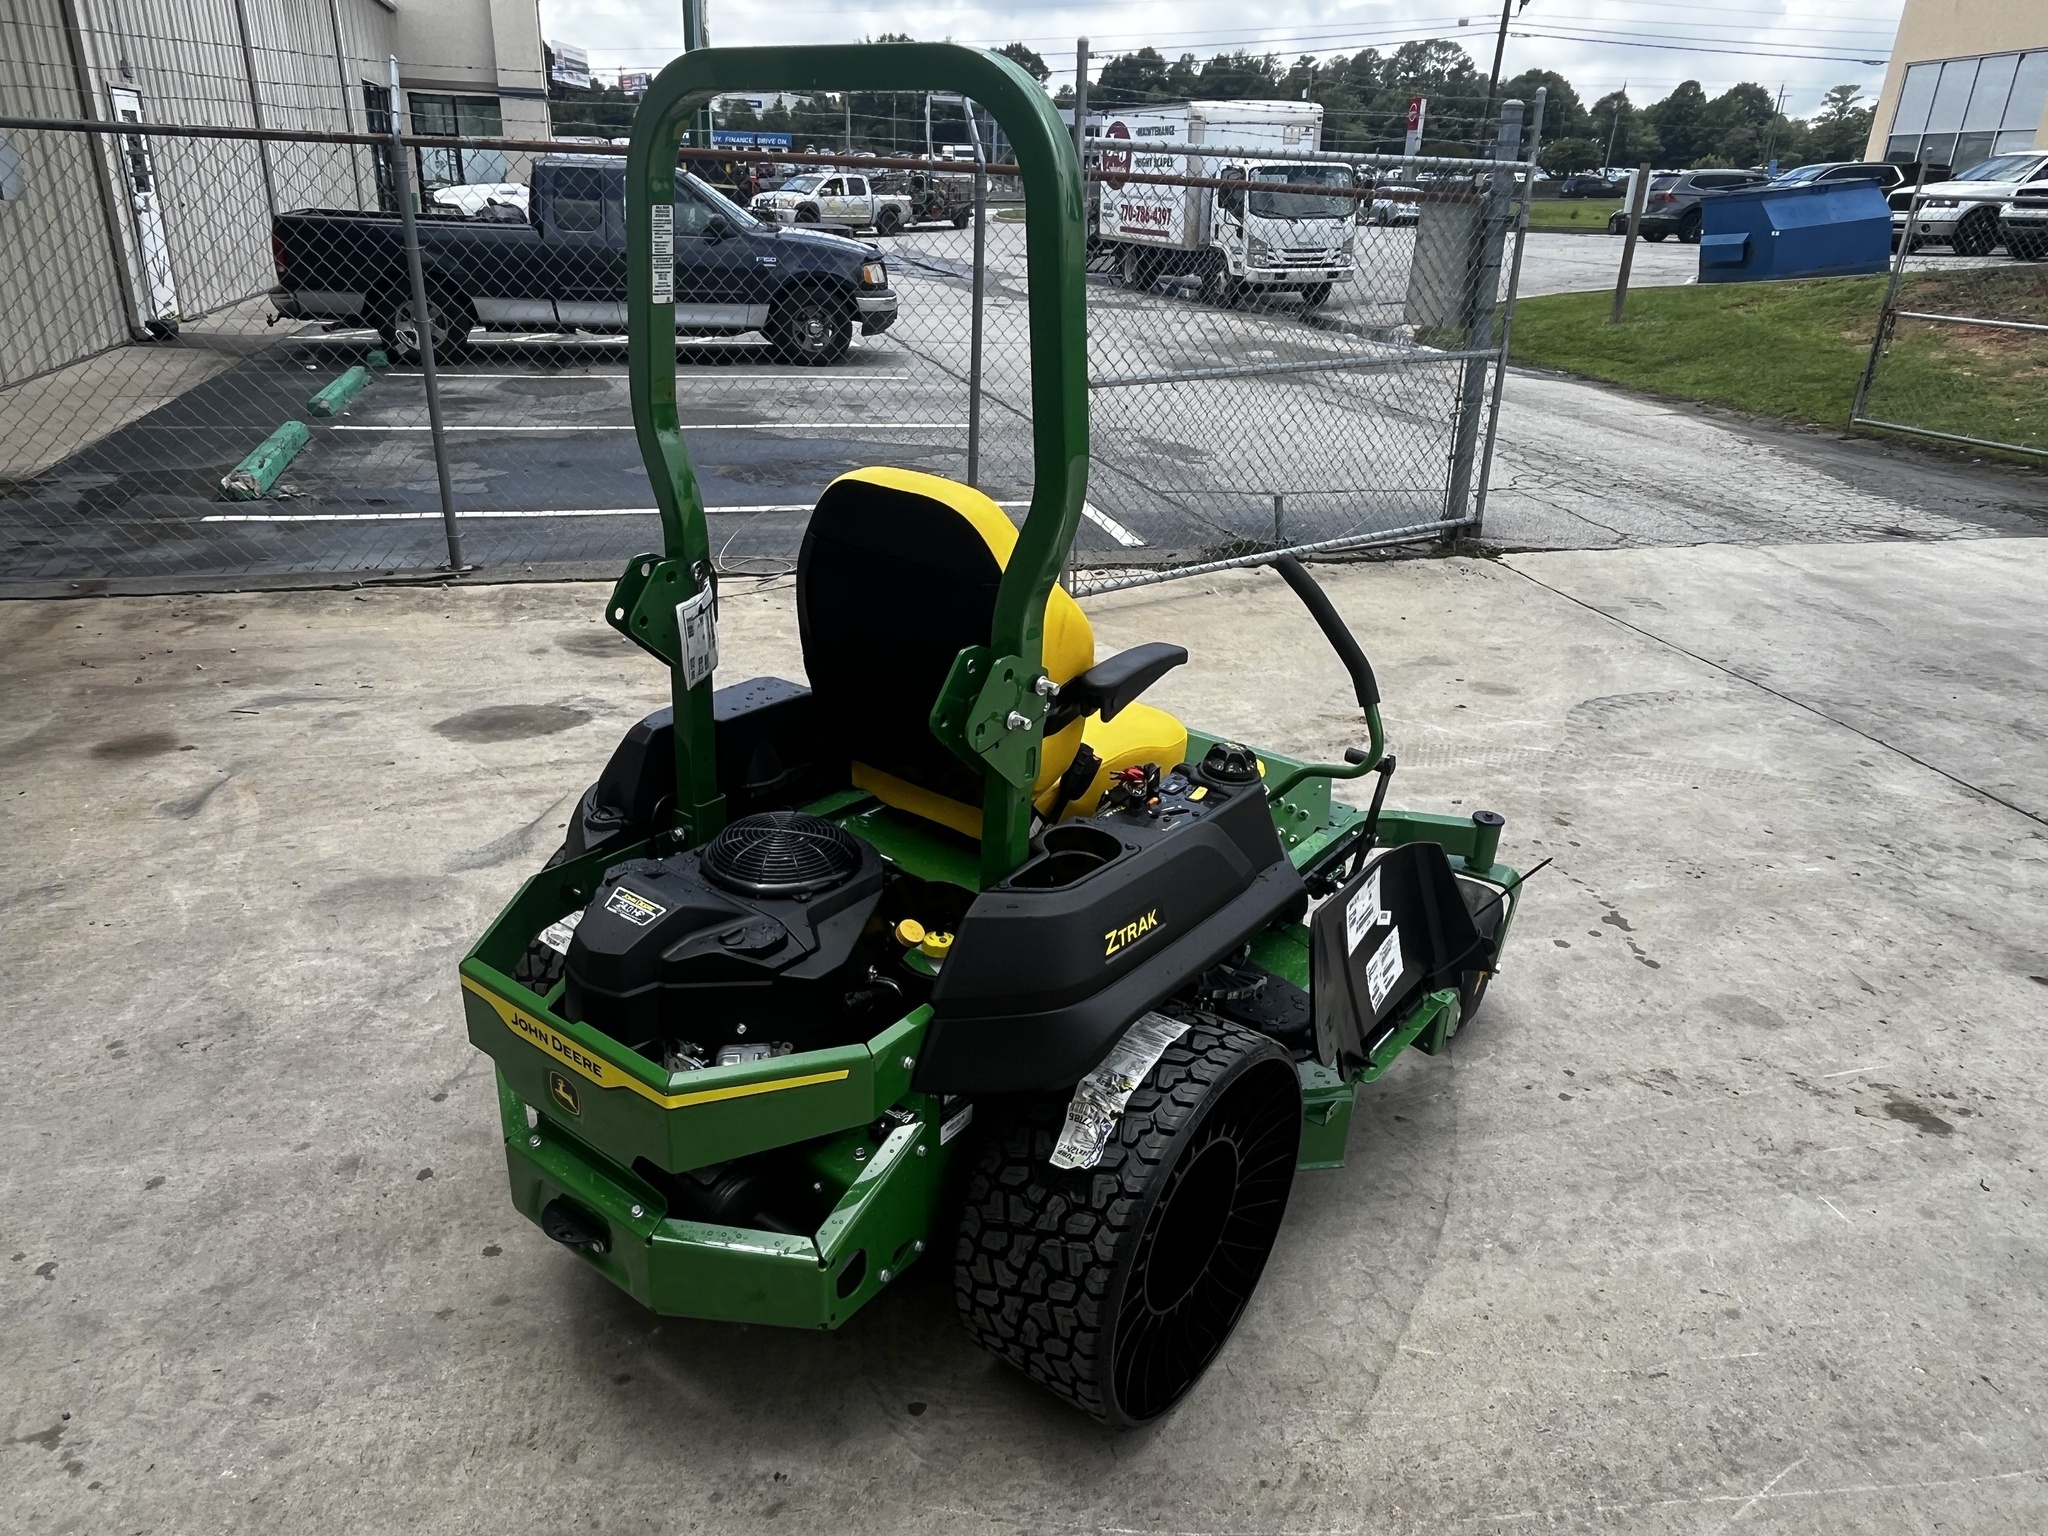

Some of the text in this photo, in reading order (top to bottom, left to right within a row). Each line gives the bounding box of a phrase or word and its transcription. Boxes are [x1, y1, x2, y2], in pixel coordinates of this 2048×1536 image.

[712, 135, 722, 143] UY.
[1104, 908, 1158, 956] ZTRAK
[511, 1012, 603, 1079] JOHN DEERE
